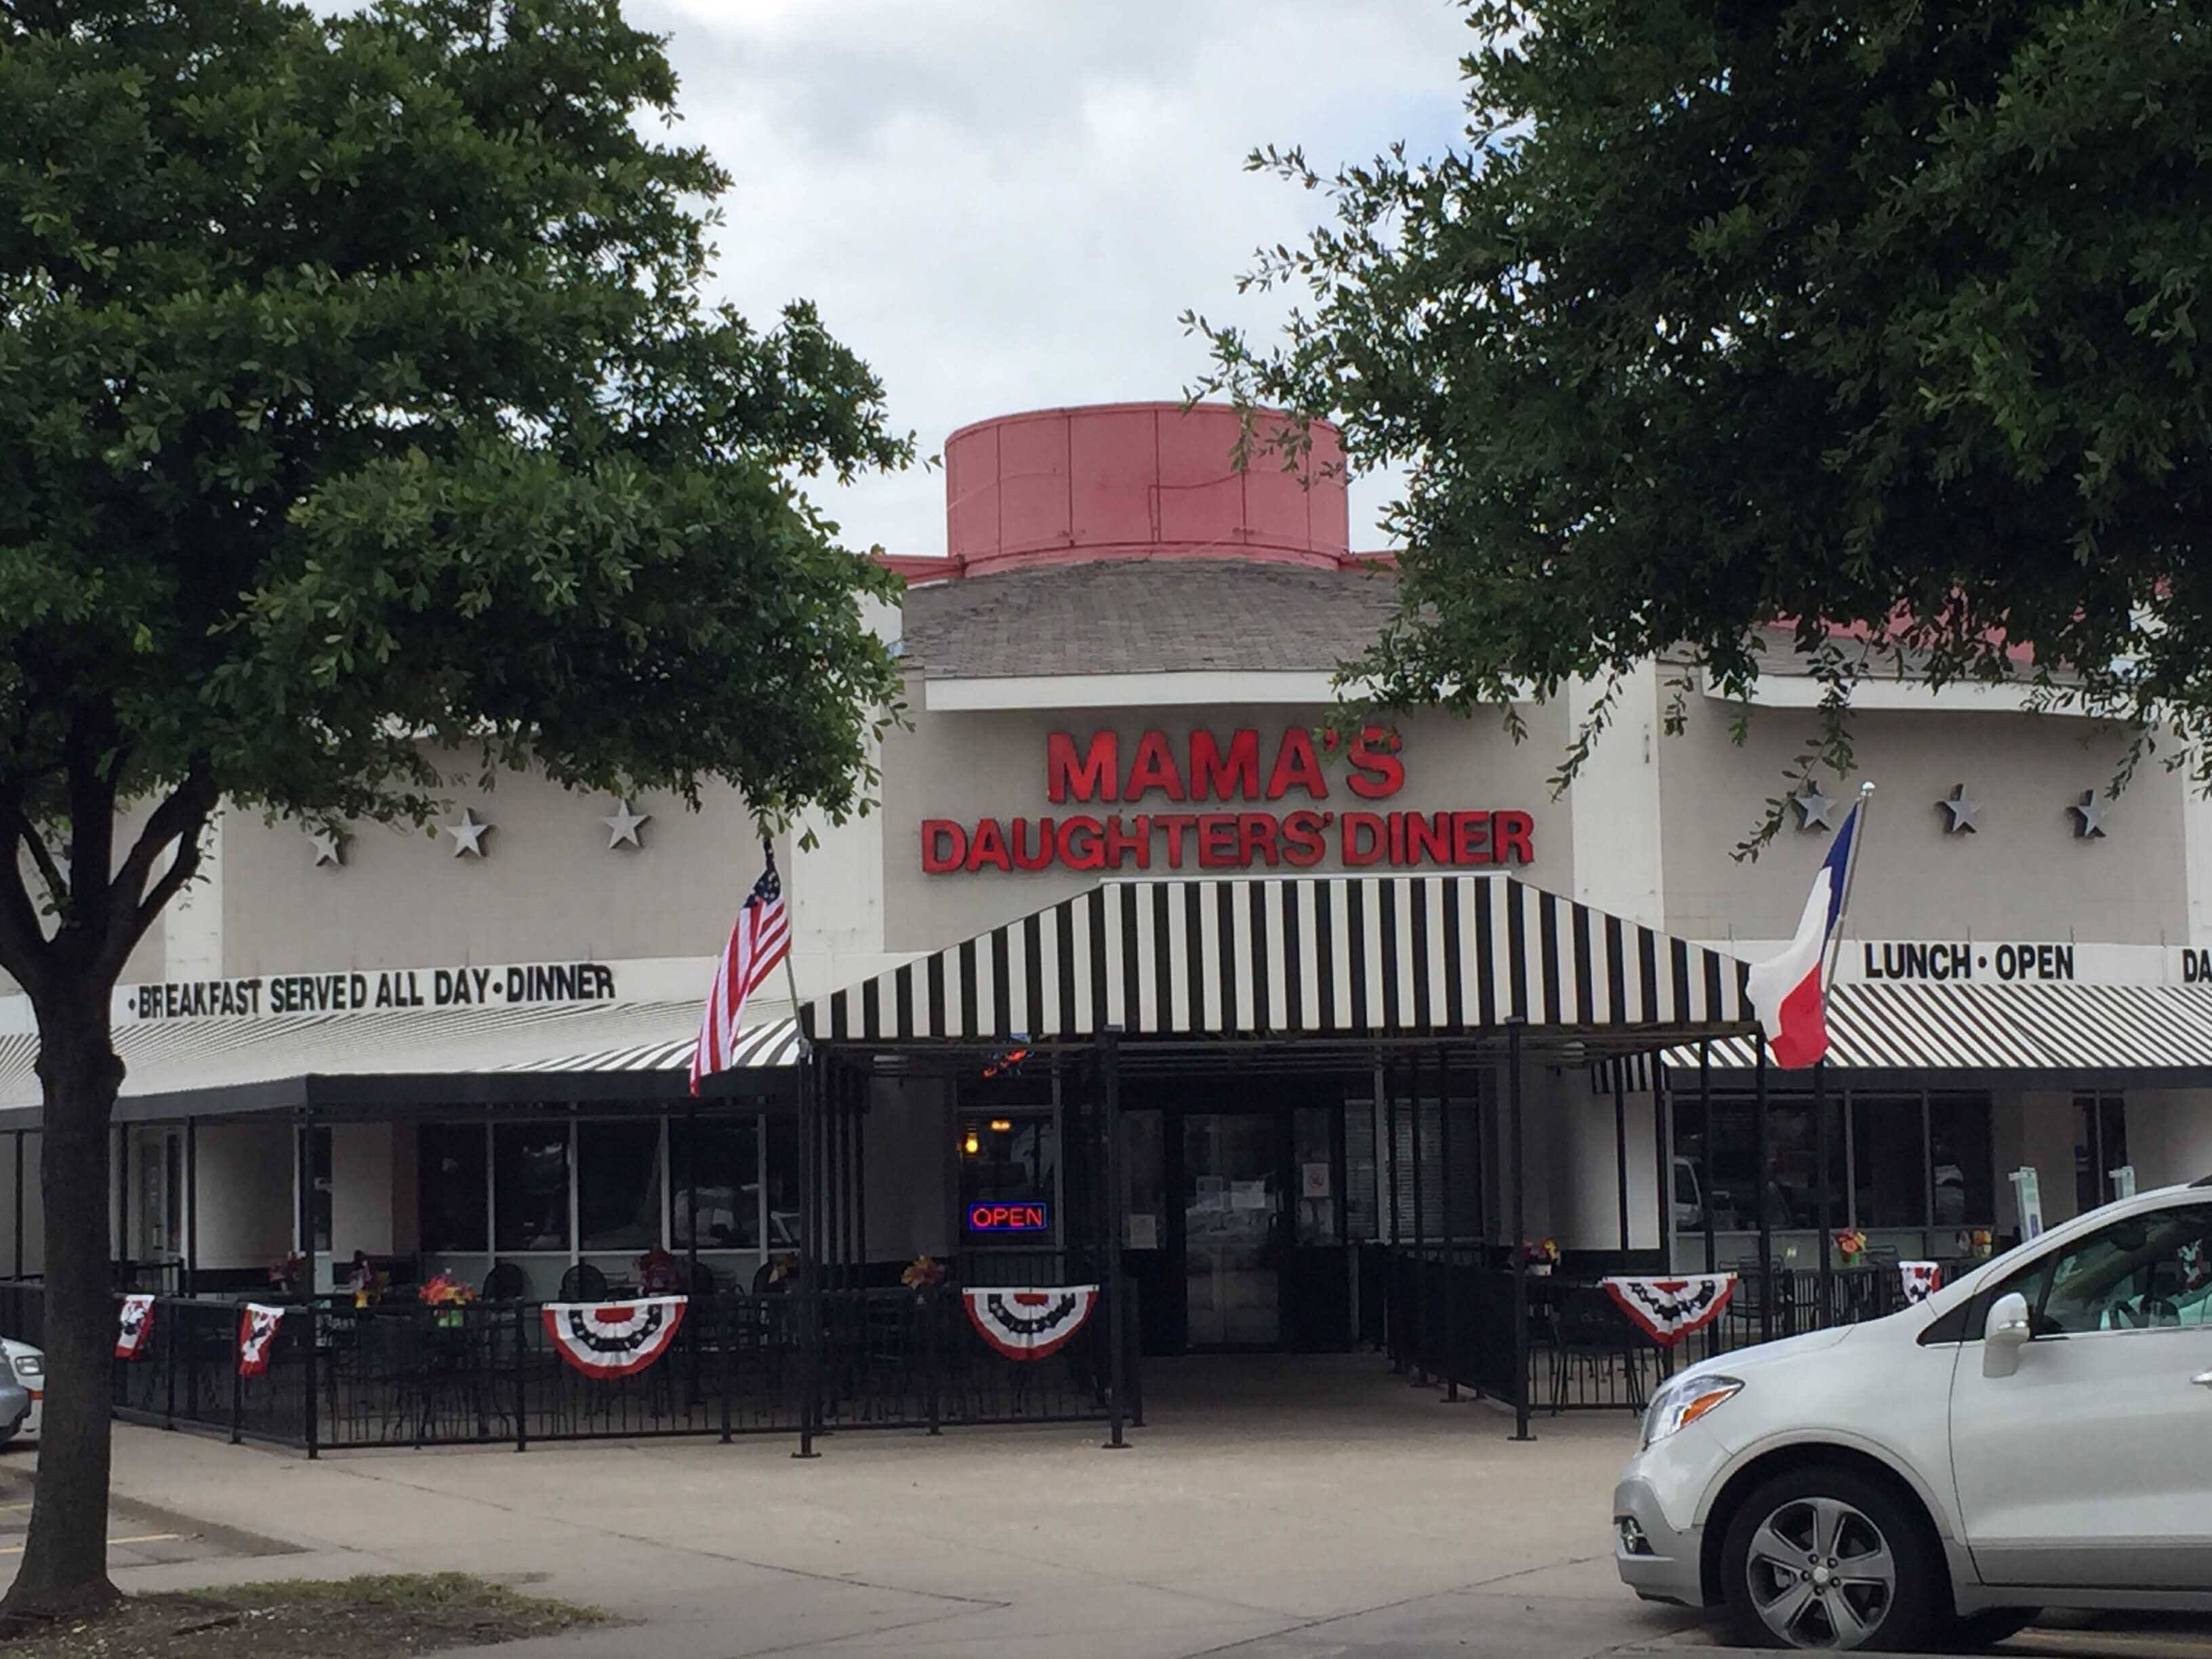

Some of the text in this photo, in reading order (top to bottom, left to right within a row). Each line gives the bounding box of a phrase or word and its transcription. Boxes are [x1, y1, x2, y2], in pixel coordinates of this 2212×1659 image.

[1047, 726, 1405, 803] MAMA'S
[922, 811, 1534, 874] DAUGHTERS' DINER
[1864, 943, 1971, 981] LUNCH
[1995, 944, 2074, 981] OPEN
[139, 979, 262, 1019] BREAKFAST
[270, 972, 367, 1014] SERVED
[375, 971, 424, 1008] ALL
[972, 1206, 1042, 1227] OPEN
